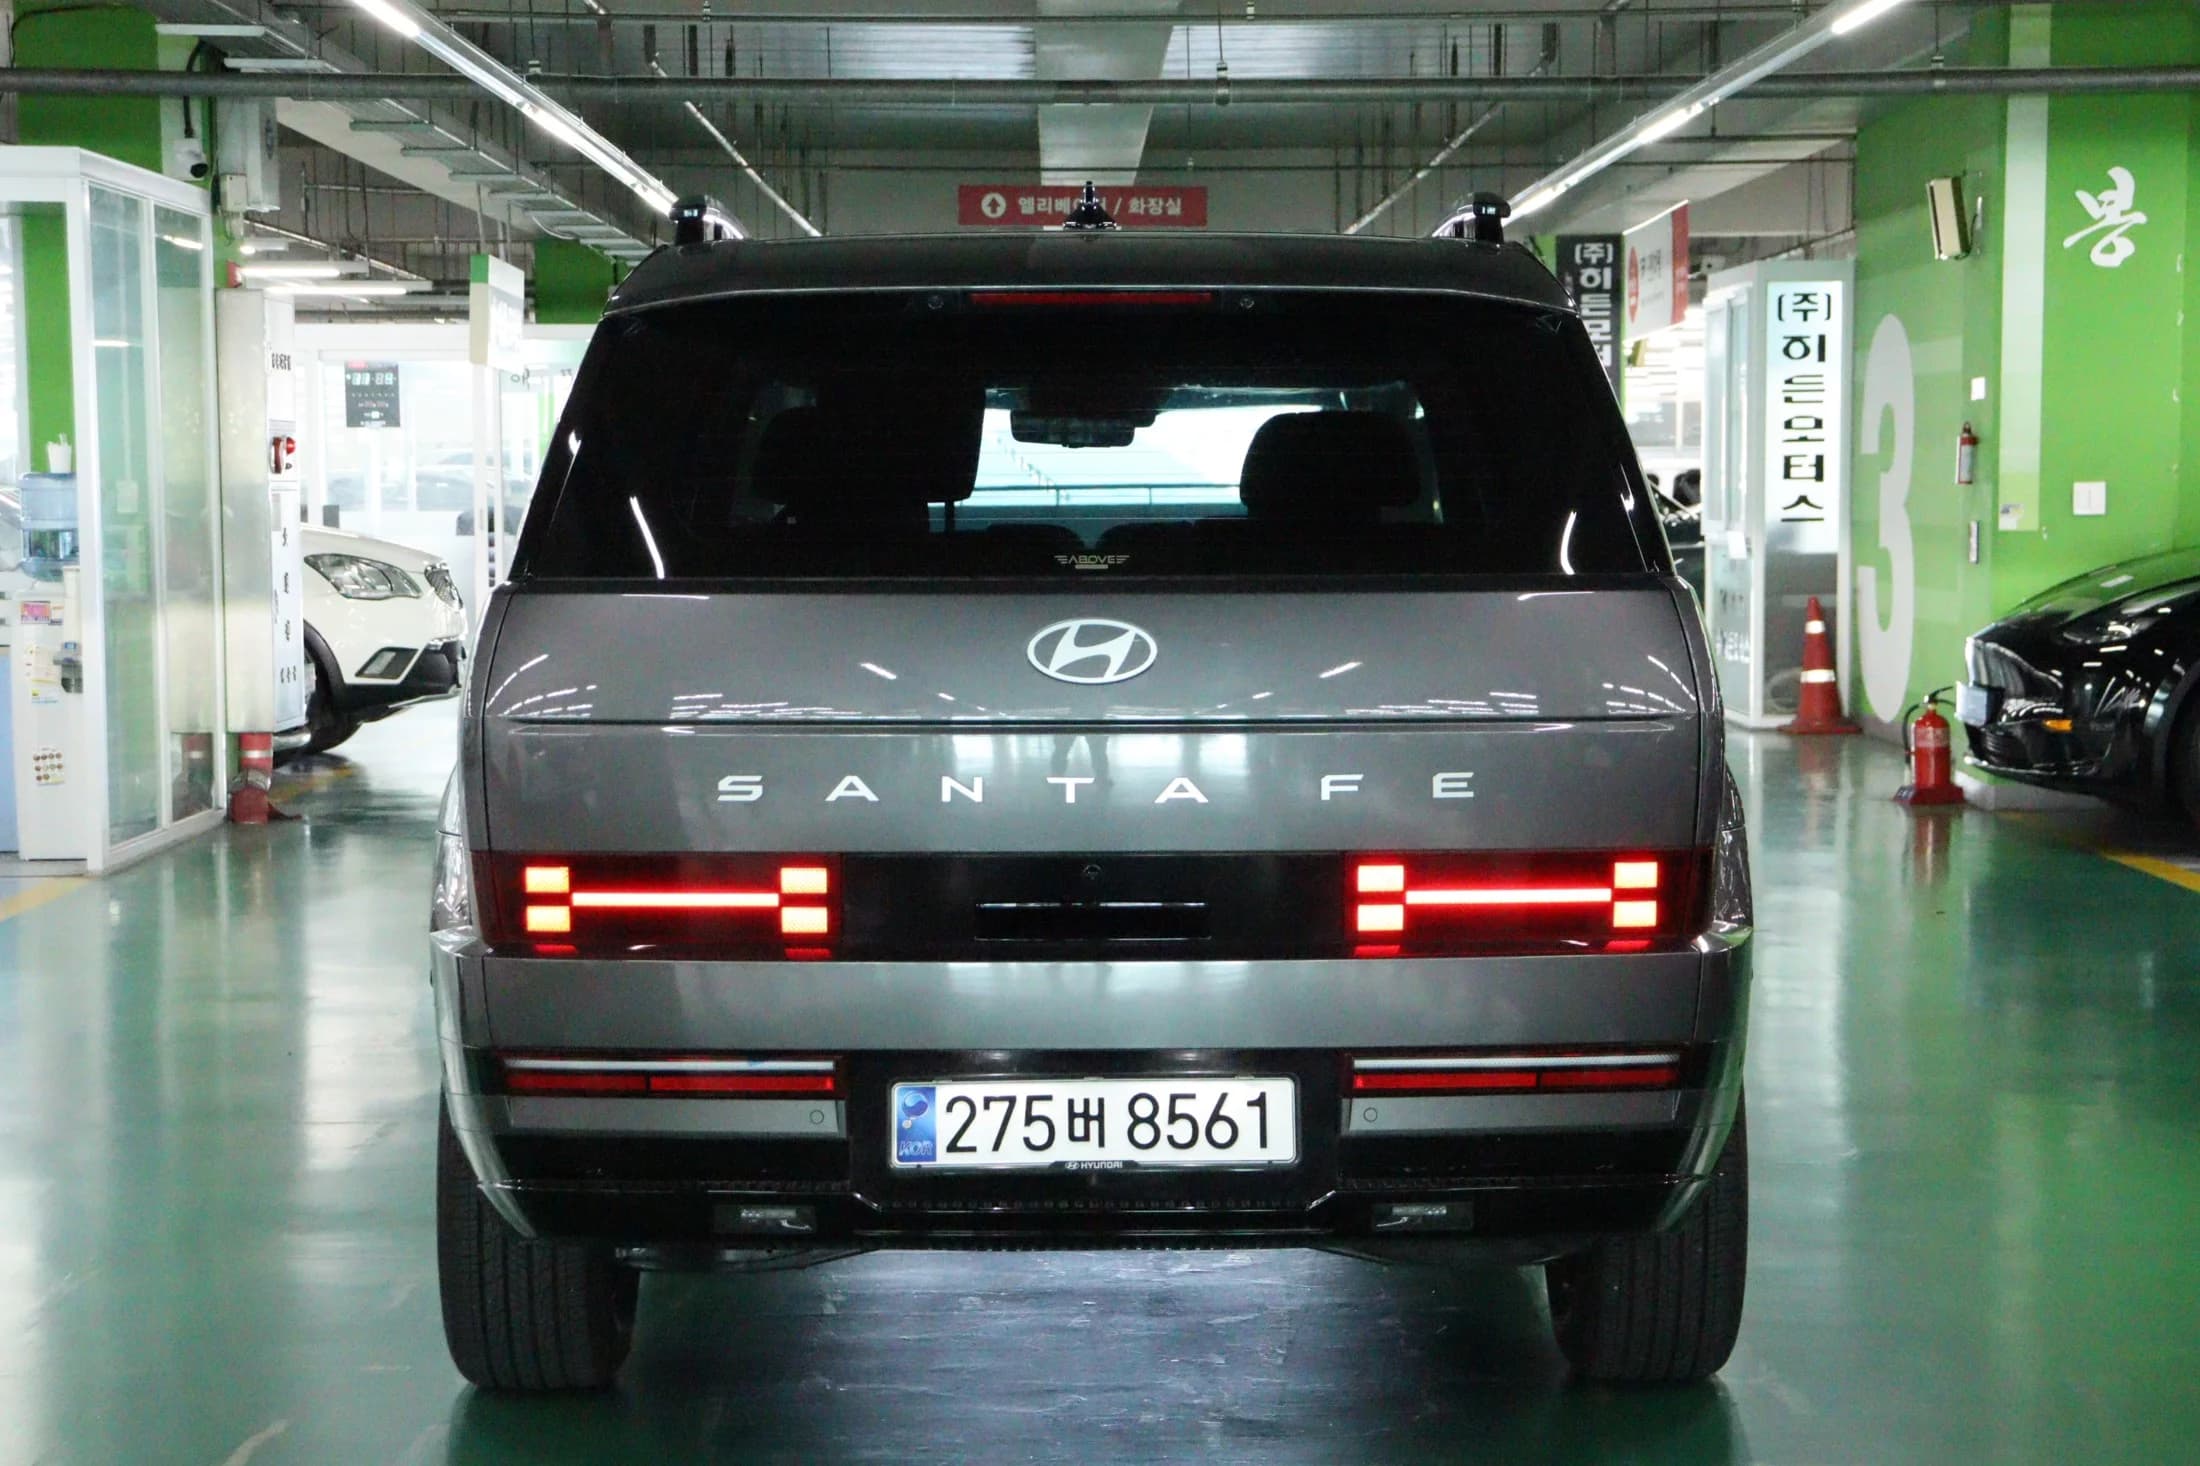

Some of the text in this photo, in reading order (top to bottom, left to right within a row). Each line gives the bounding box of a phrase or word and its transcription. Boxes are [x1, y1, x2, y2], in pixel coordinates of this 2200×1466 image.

[1018, 196, 1107, 215] 엘리베
[1128, 197, 1182, 215] 화장실
[1857, 314, 1914, 723] 3
[1068, 554, 1116, 564] ABOVE
[717, 772, 1475, 804] SANTA FE
[1127, 1091, 1268, 1151] 8561
[1080, 1160, 1123, 1169] HYUNDAI
